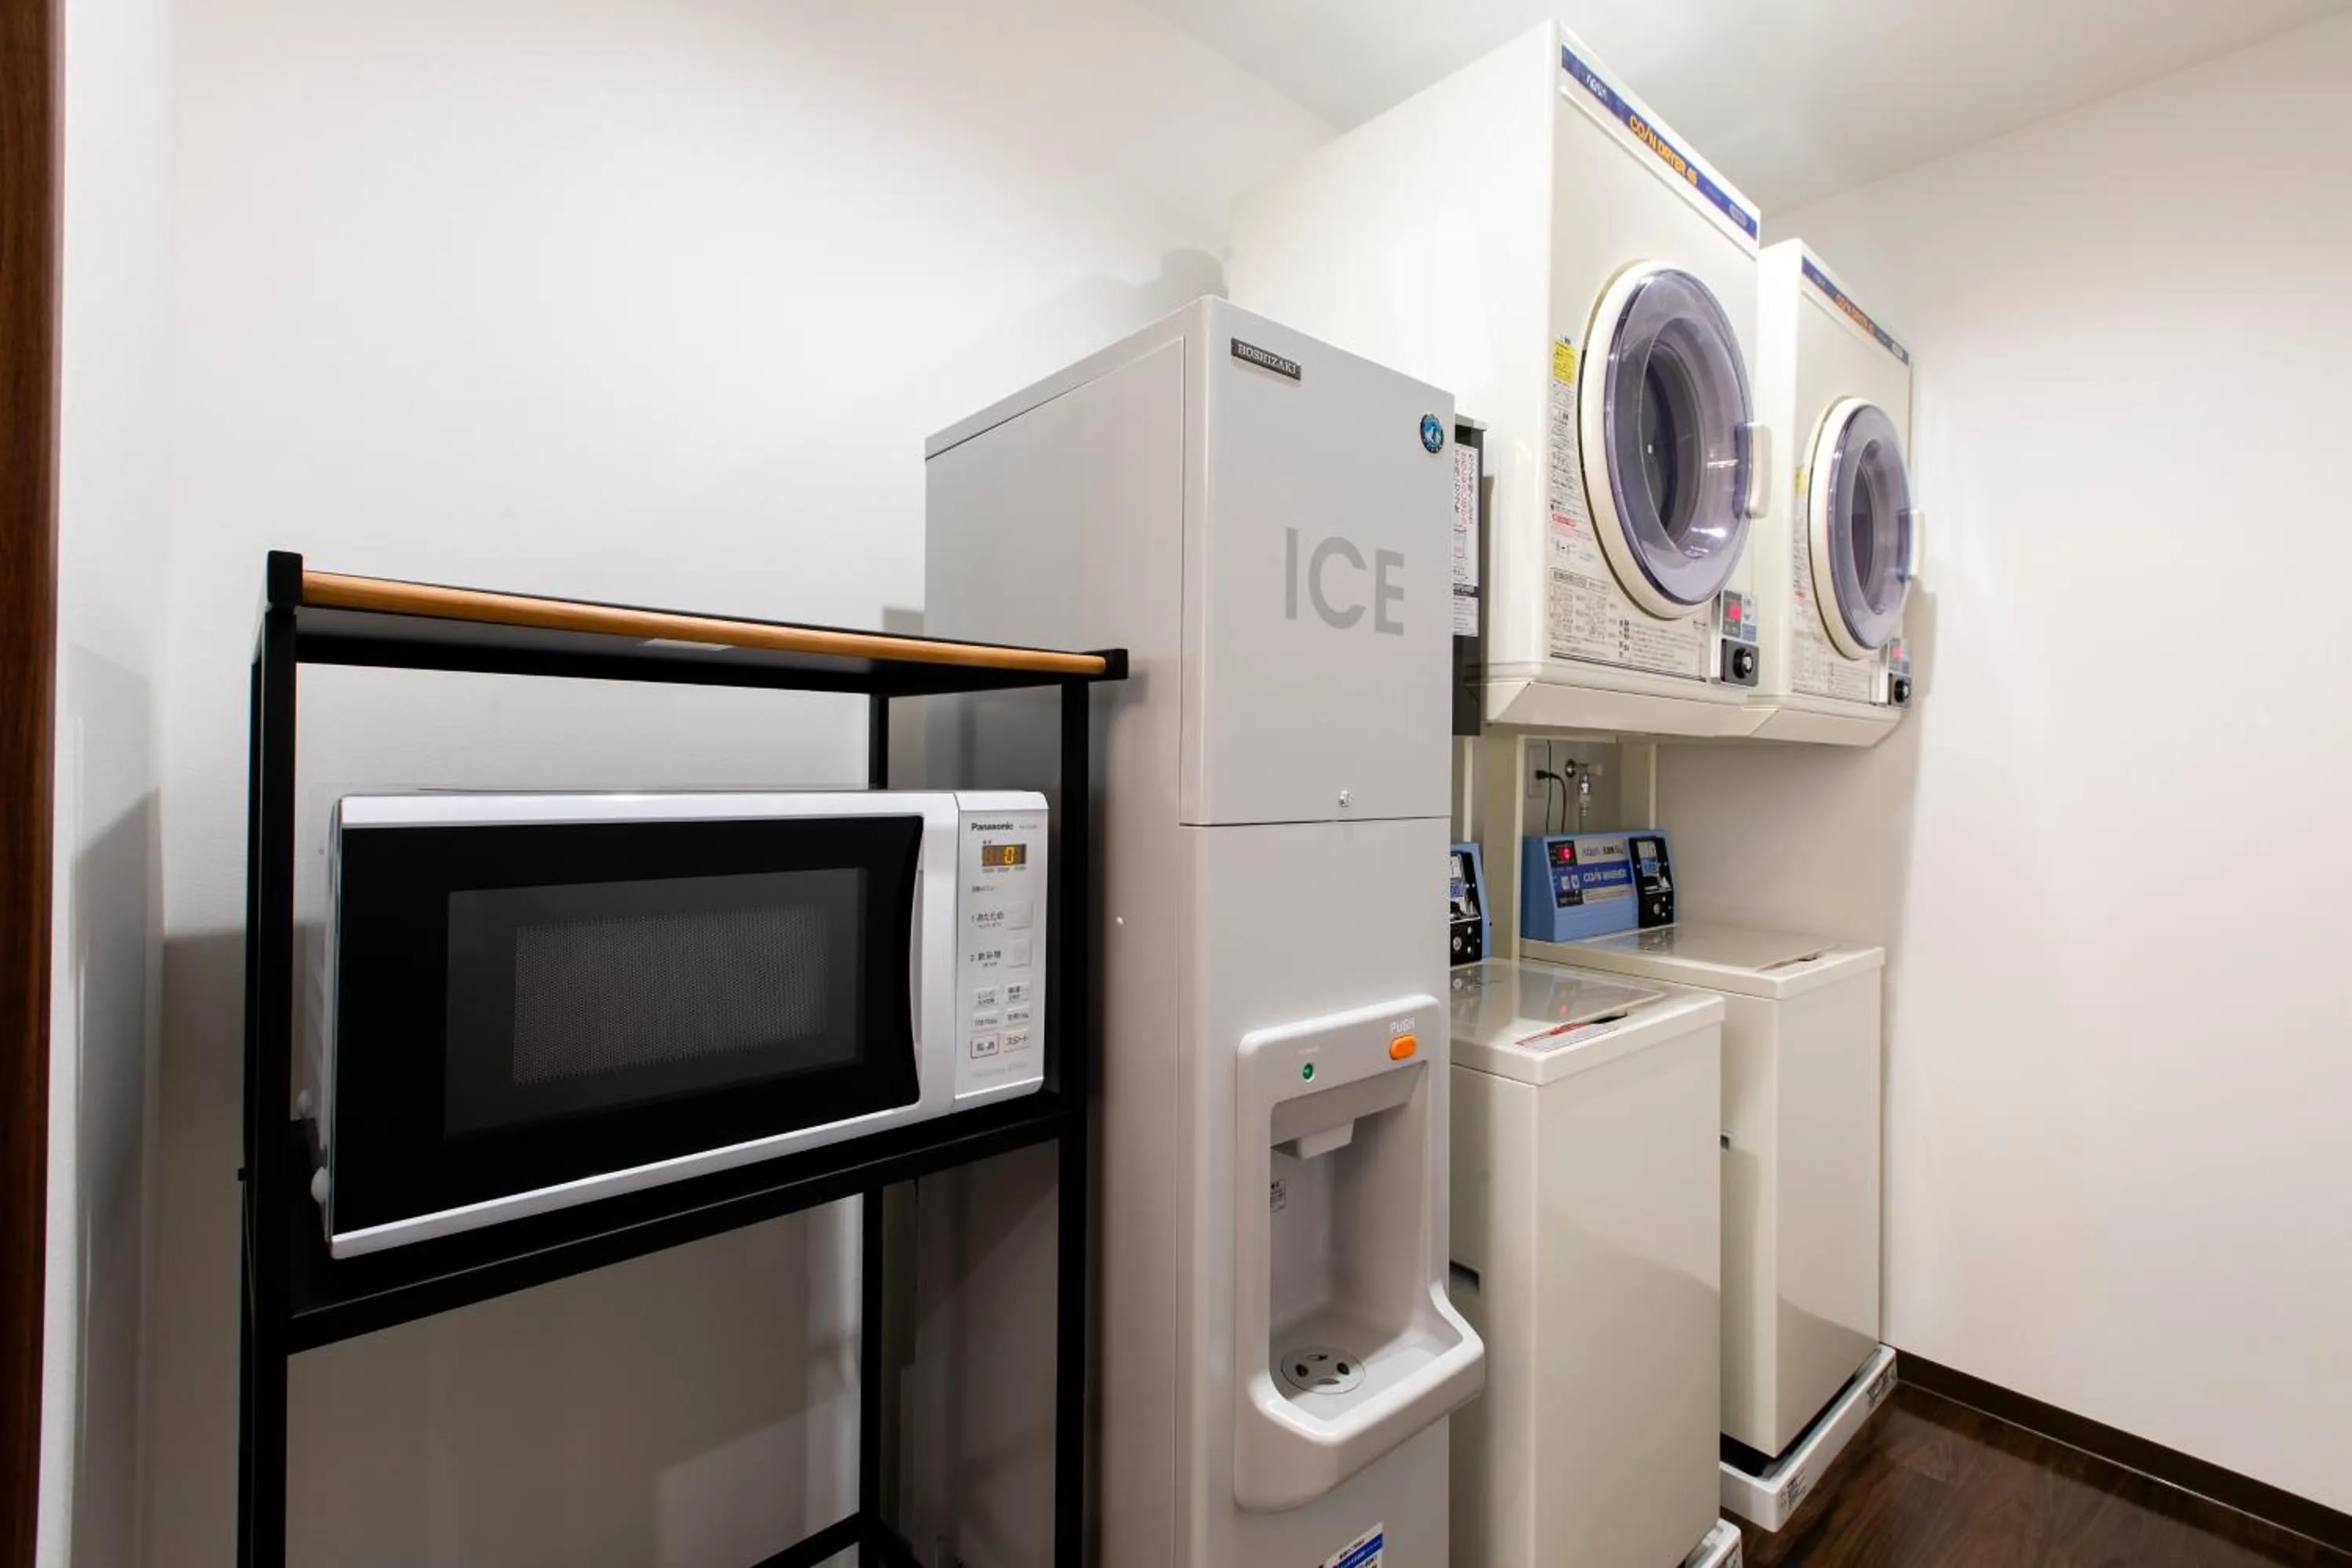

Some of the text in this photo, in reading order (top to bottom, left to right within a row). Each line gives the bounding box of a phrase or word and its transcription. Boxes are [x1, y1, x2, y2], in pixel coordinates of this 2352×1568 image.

[1237, 343, 1297, 375] HOSHIZAKI
[1286, 527, 1405, 636] ICE
[971, 822, 1013, 831] Panasonic
[1390, 1018, 1415, 1033] PUSH
